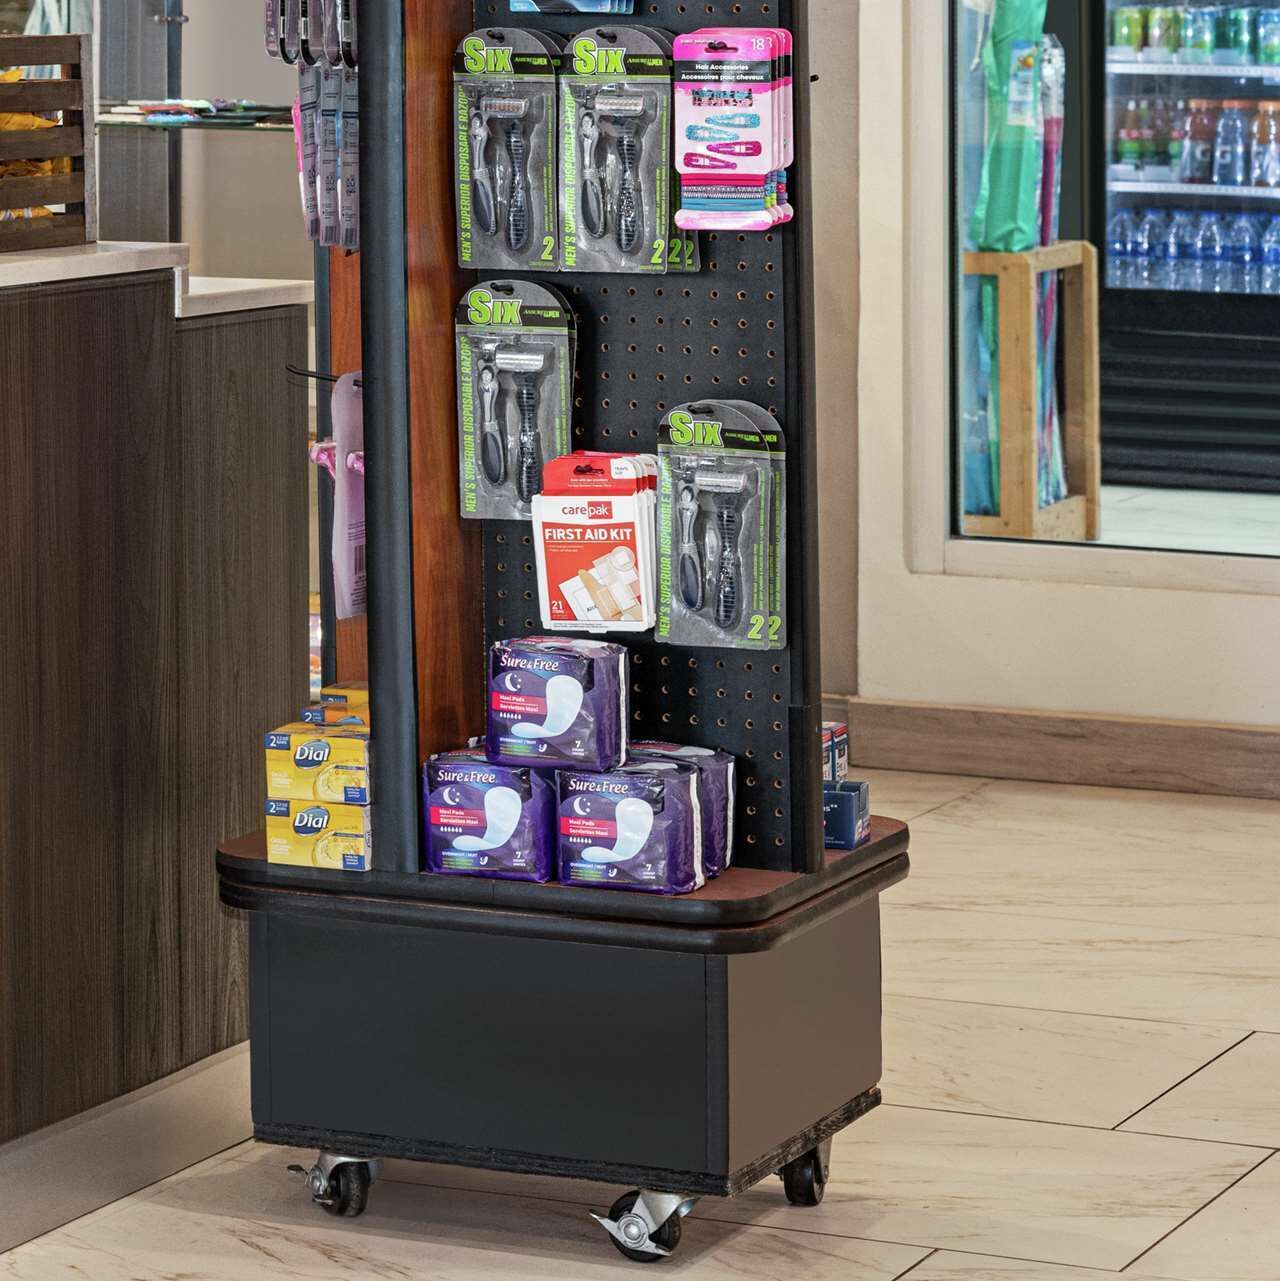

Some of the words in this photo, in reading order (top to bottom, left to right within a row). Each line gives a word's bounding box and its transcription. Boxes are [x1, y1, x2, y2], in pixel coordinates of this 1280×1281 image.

[463, 37, 513, 74] SIX
[574, 37, 626, 74] SIX
[751, 38, 764, 50] 18
[681, 73, 719, 81] Accessoires
[720, 74, 736, 82] pour
[460, 184, 471, 230] SUPERIOR
[462, 232, 472, 262] MEN'S
[542, 237, 554, 260] 2
[651, 239, 663, 264] 2
[468, 289, 522, 326] SIX
[462, 375, 474, 432] DISPOSABLE
[669, 411, 725, 447] SIX
[463, 434, 475, 480] SUPERIOR
[464, 483, 476, 512] MEN'S
[545, 528, 583, 540] FIRST
[585, 528, 607, 540] AID
[610, 528, 632, 539] KIT
[660, 557, 671, 605] SUPERIOR
[552, 601, 562, 609] 21
[658, 606, 670, 637] MEN'S
[748, 614, 764, 638] 2
[500, 653, 560, 671] Sure&Free
[296, 746, 329, 761] Dial
[569, 778, 628, 794] Sure&Free
[295, 813, 328, 828] Dial
